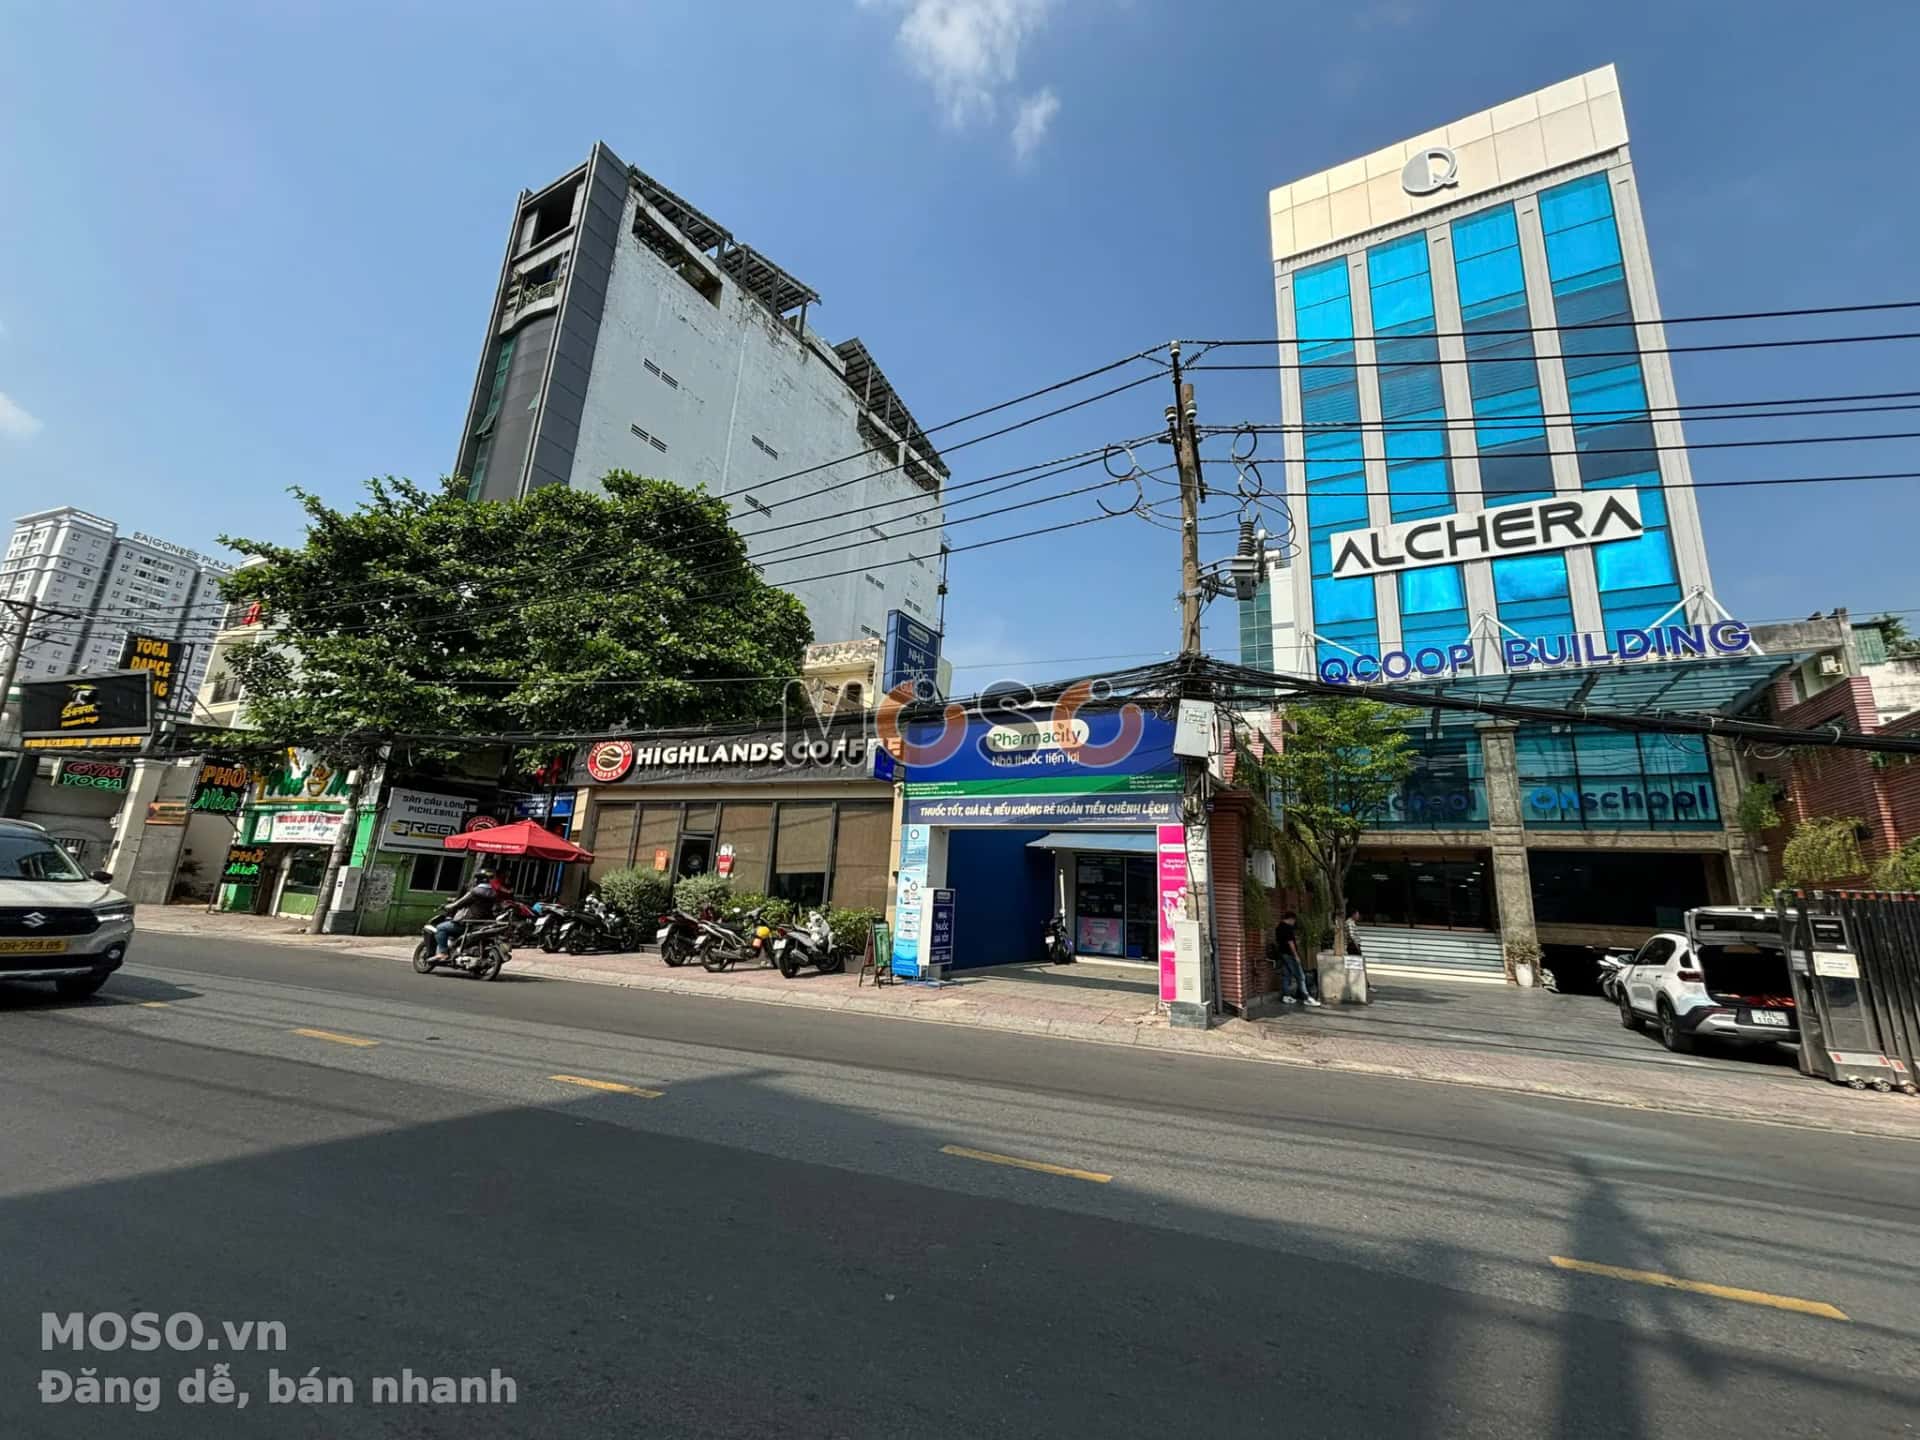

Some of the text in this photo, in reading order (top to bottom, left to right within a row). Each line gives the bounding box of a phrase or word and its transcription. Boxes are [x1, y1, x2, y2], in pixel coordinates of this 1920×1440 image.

[1332, 496, 1642, 573] ALCHERA
[136, 637, 169, 658] YOGA
[1320, 620, 1752, 684] QCOOP BUILDING
[636, 744, 784, 766] HIGHLANDS
[62, 773, 122, 789] YOGA
[66, 763, 123, 778] GYM
[1531, 784, 1710, 812] Onschool
[920, 803, 947, 817] THUỐC
[965, 804, 979, 816] GIÁ
[993, 801, 1012, 815] NẾU
[1011, 803, 1042, 815] KHÔNG
[1056, 802, 1083, 815] HOÀN
[1107, 801, 1140, 814] CHÊNH
[1142, 801, 1169, 816] LỆCH
